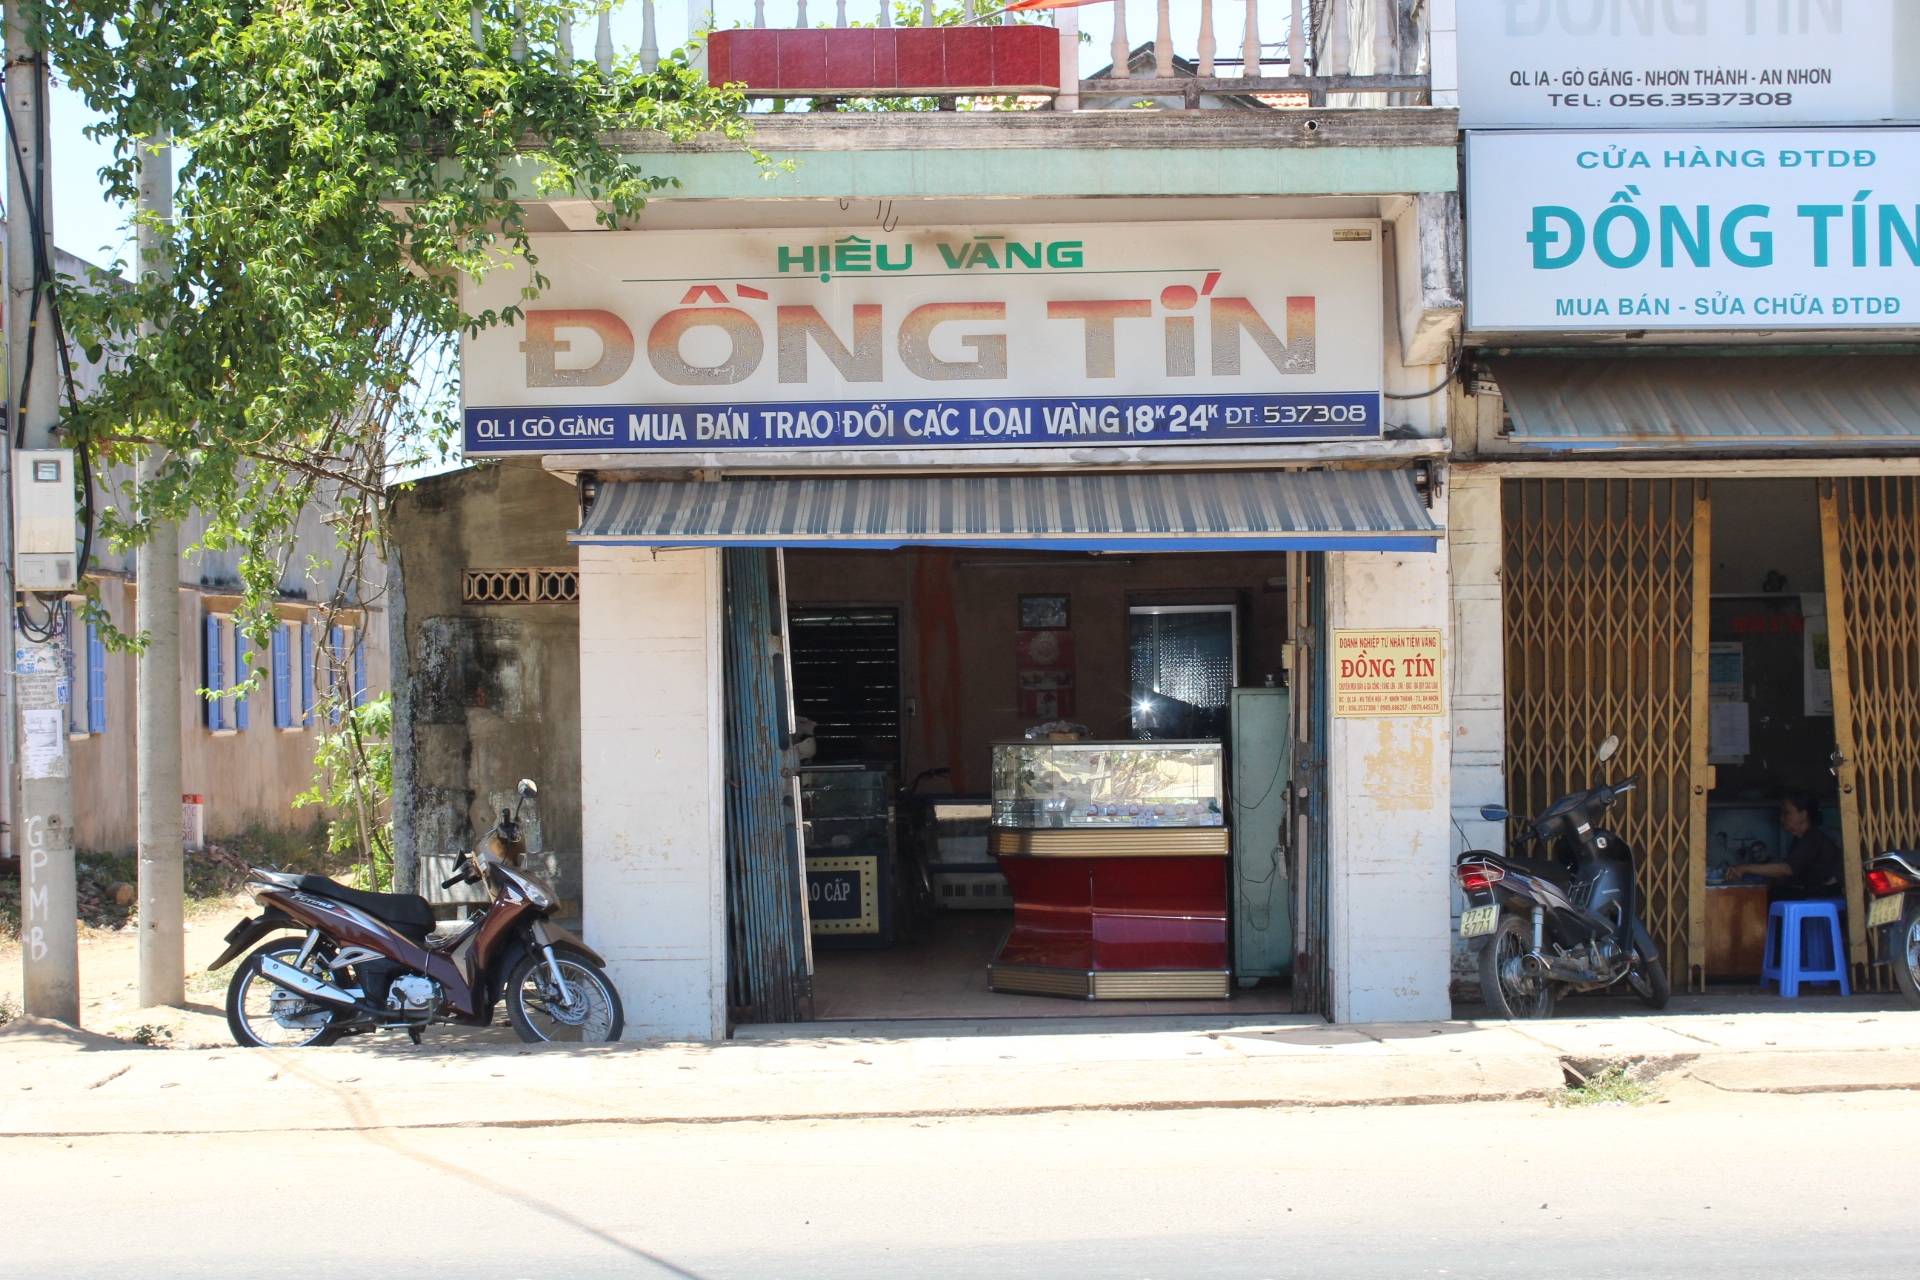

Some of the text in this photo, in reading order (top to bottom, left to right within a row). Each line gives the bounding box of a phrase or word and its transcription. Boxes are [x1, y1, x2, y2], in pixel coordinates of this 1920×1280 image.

[1509, 70, 1531, 87] QL
[1562, 67, 1585, 87] GÒ
[1645, 69, 1690, 87] NHƠN
[1694, 66, 1747, 86] THÀNH
[1759, 70, 1783, 86] AN
[1786, 67, 1832, 86] NHƠN
[1548, 92, 1793, 107] TEL: 056.3537308
[1576, 144, 1877, 169] CỬA HÀNG ĐTDĐ
[1526, 184, 1920, 270] ĐỒNG TÍN
[777, 234, 912, 284] HIỆU
[519, 284, 1008, 388] ĐỒNG
[477, 418, 505, 439] QL
[508, 419, 515, 437] 1
[521, 415, 555, 437] GÒ
[629, 413, 688, 442] MUA
[696, 407, 750, 441] BÁN
[760, 410, 833, 440] TRAO
[842, 404, 895, 439] ĐỔI
[903, 403, 960, 438] CÁC
[969, 406, 1032, 438] LOẠI
[1042, 402, 1120, 437] VÀNG
[1225, 407, 1259, 425] ĐT:
[1264, 404, 1367, 424] 537308
[1340, 637, 1358, 648] DOANH
[1360, 635, 1379, 649] NGHIỆP
[1341, 649, 1436, 678] ĐỒNG TÍN
[824, 877, 851, 902] CẤP
[1466, 906, 1493, 923] 77-X7
[1463, 920, 1490, 936] 5771
